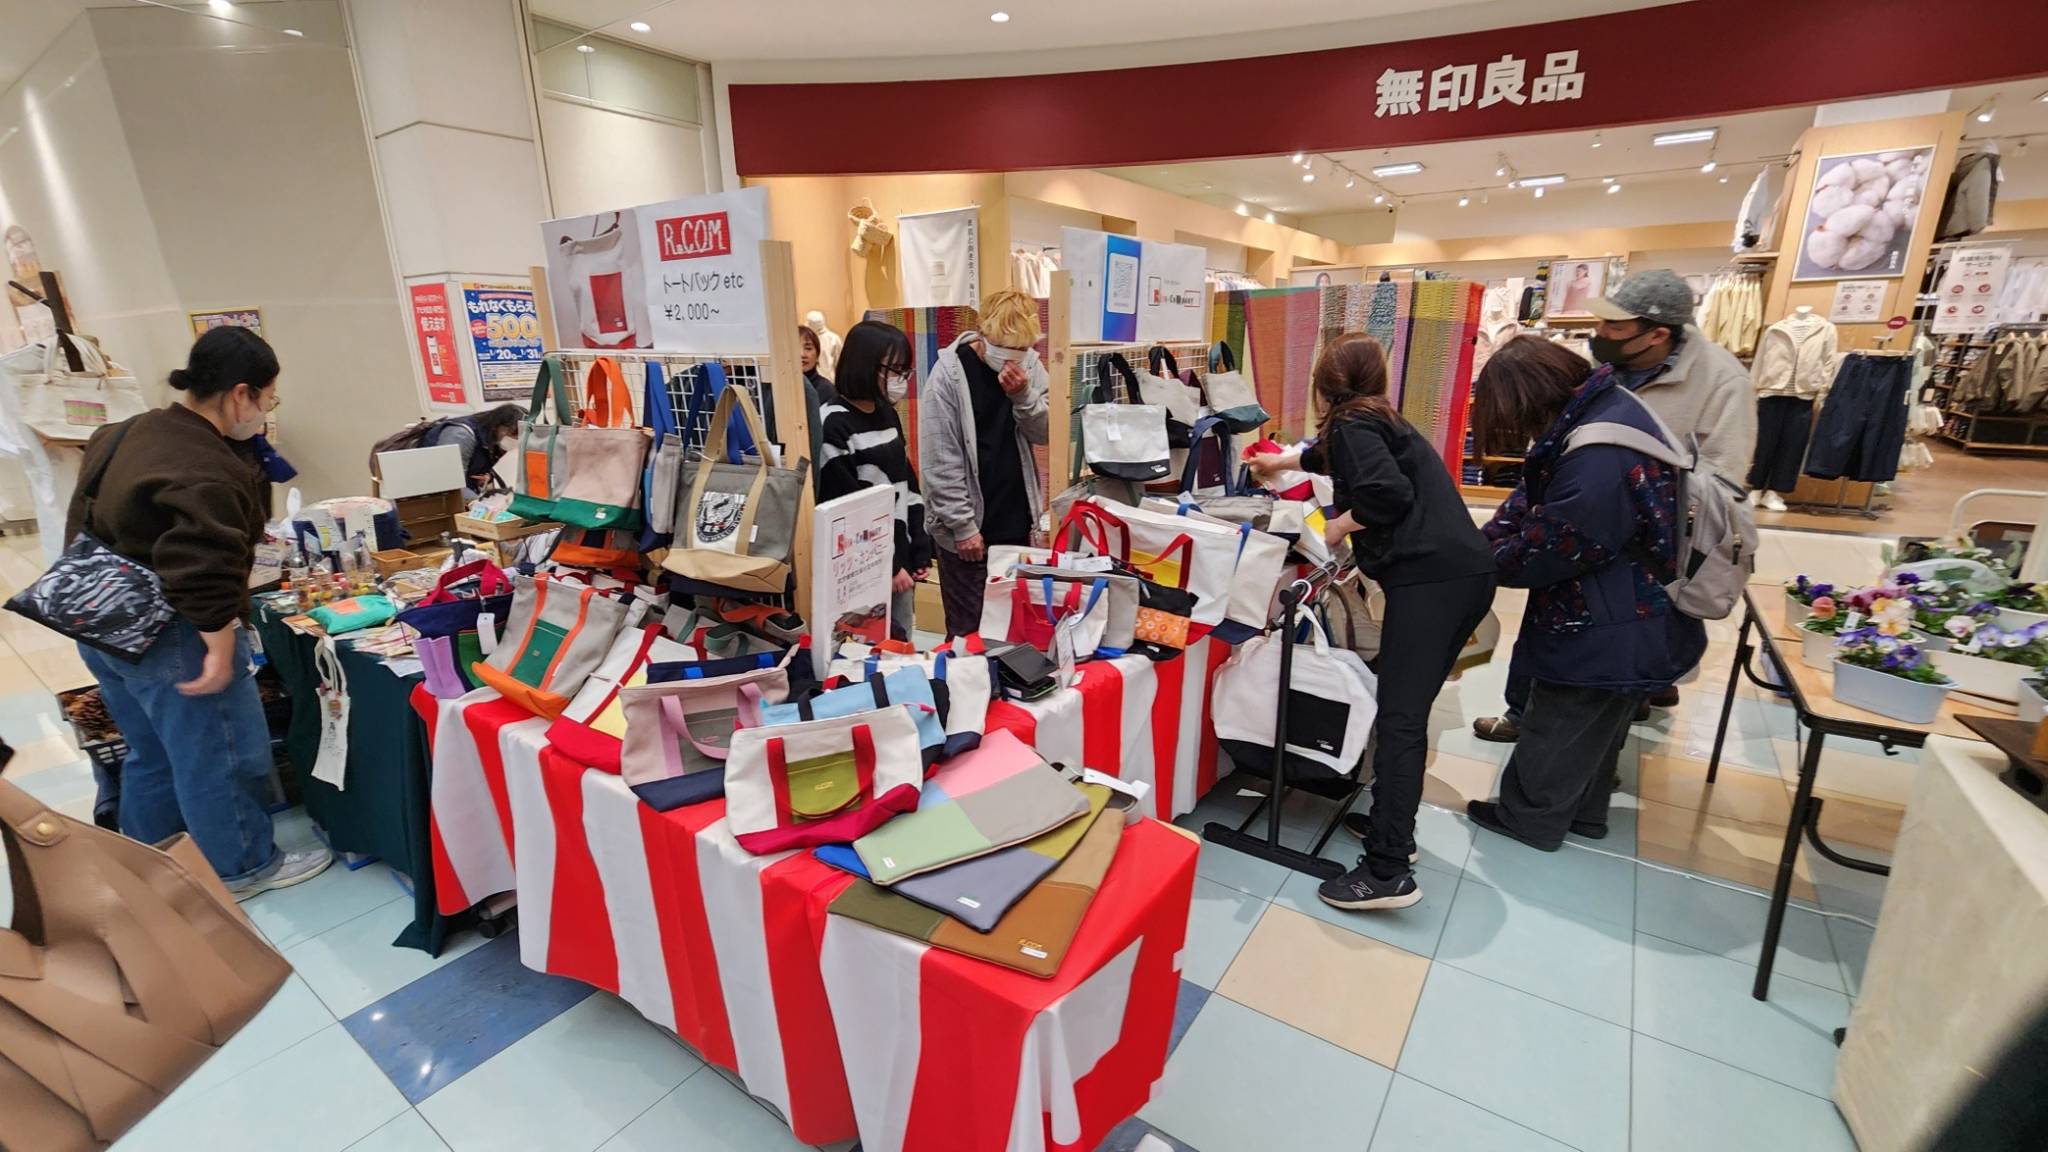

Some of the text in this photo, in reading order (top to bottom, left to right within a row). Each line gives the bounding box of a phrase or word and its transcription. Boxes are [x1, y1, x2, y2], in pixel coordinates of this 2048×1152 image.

[1374, 49, 1586, 118] 無印良品
[662, 219, 728, 256] R.COM
[723, 272, 744, 288] etc
[486, 312, 537, 341] 500
